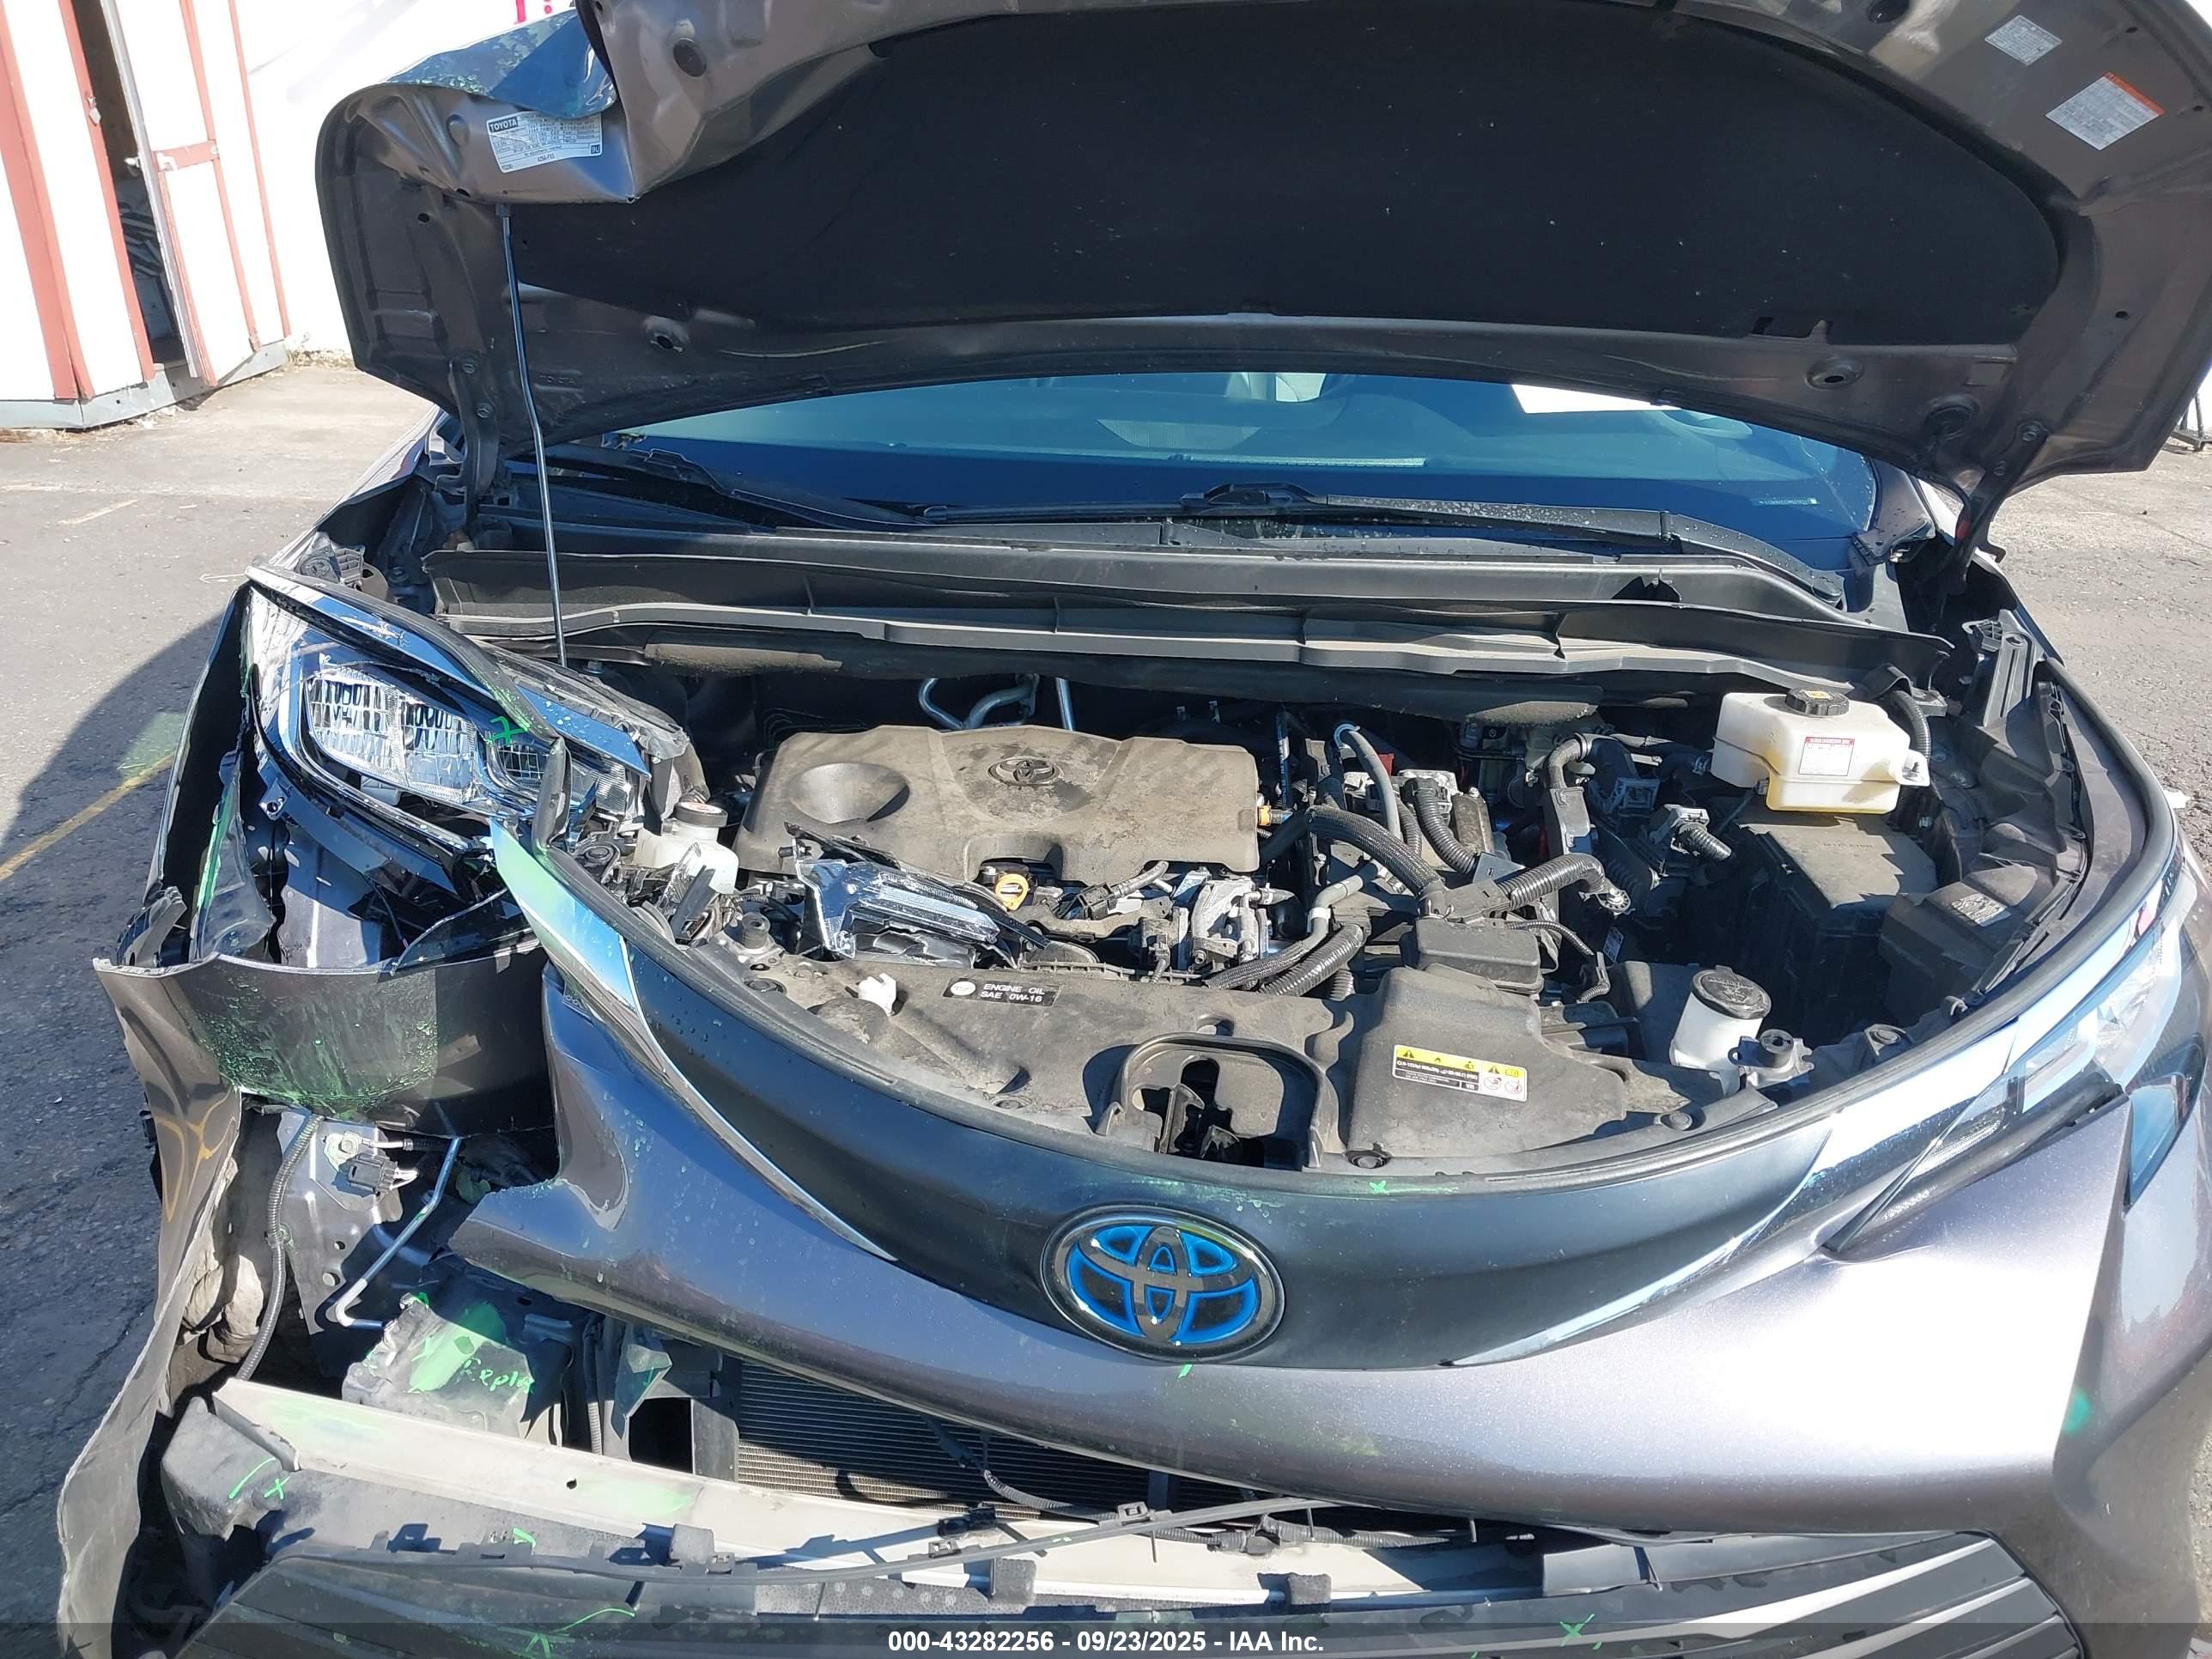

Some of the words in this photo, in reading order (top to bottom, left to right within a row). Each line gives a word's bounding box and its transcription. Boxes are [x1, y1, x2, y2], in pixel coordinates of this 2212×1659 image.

[489, 118, 517, 132] TOYOTA
[983, 983, 1023, 993] ENGINE
[1029, 987, 1045, 995] OIL
[980, 991, 1002, 1000] SAE
[1009, 994, 1042, 1002] 0W-16
